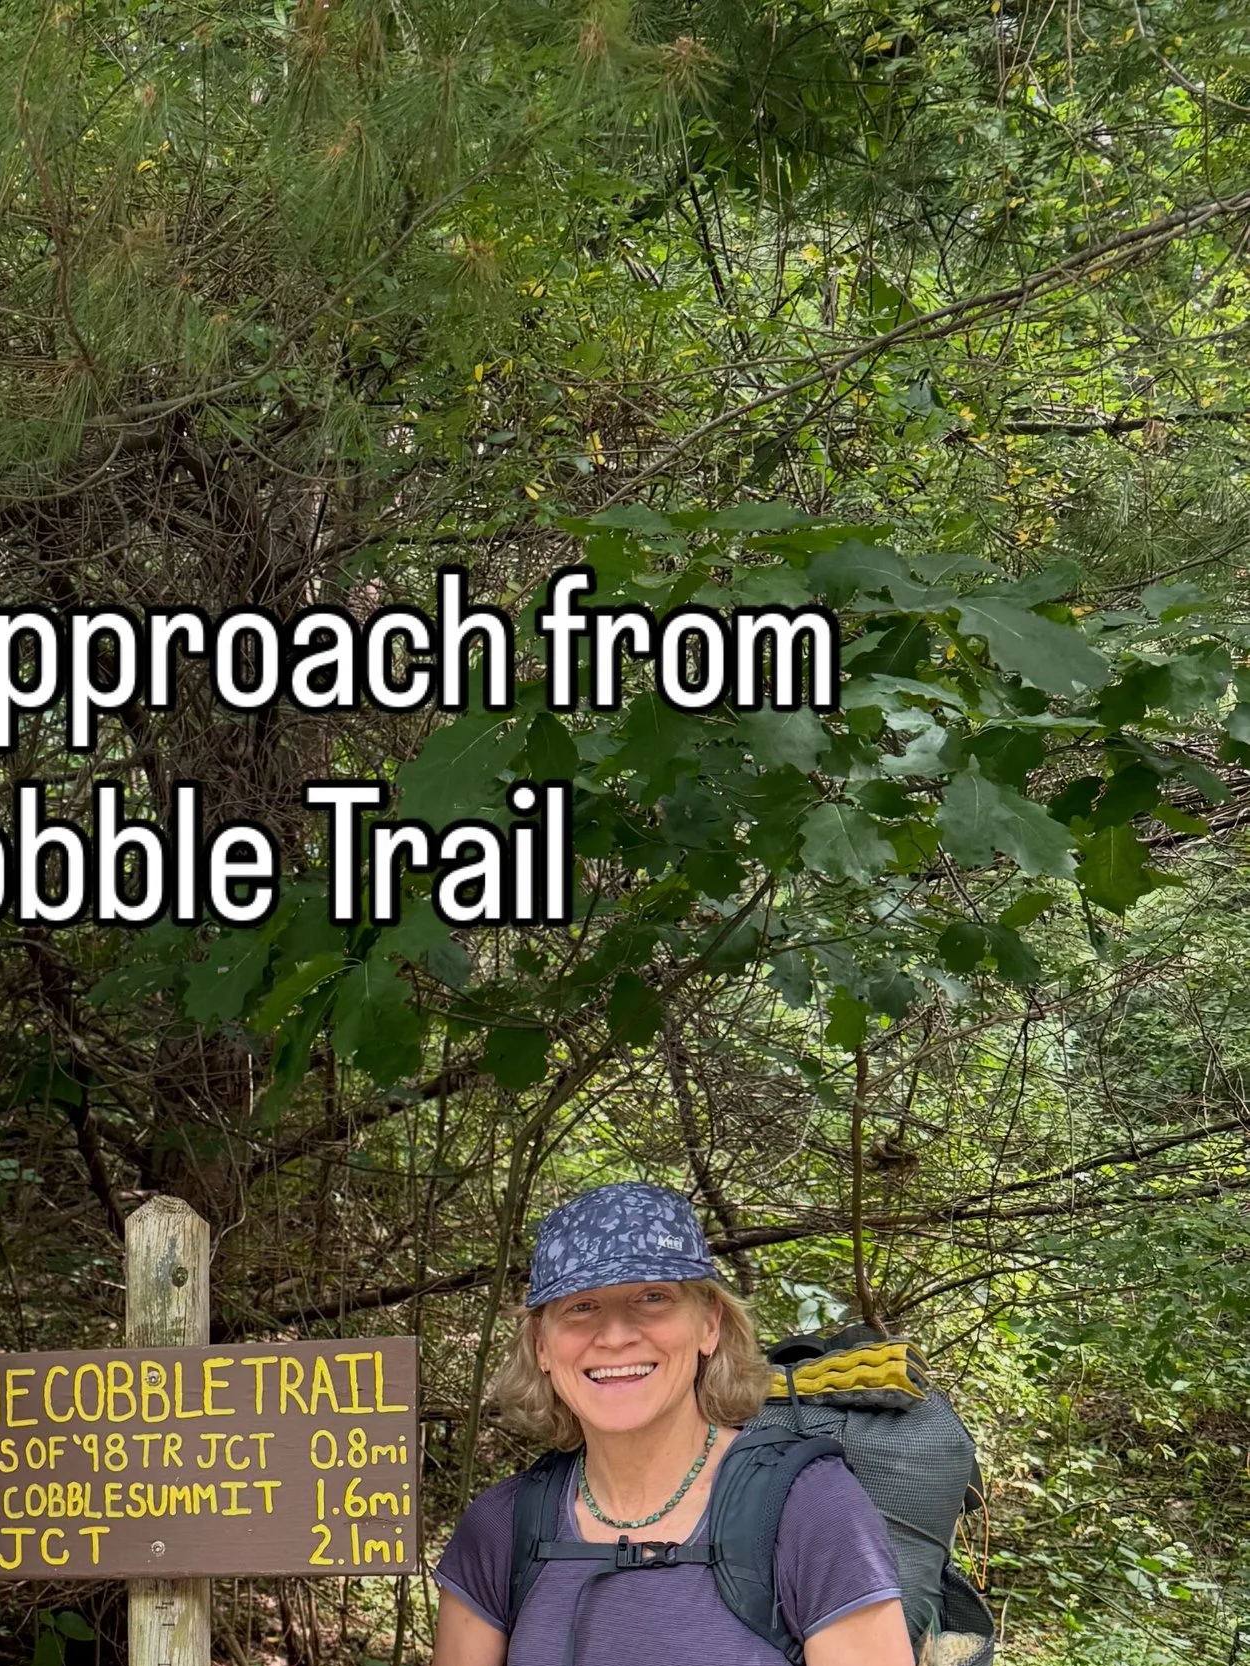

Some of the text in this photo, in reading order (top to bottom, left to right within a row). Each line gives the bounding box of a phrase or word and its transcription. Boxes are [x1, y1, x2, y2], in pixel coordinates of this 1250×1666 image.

[43, 1357, 236, 1423] COBBLE
[240, 1351, 410, 1416] TRAIL
[25, 1435, 68, 1470] OF
[132, 1432, 184, 1469] TR
[196, 1432, 276, 1470] JCT
[2, 1481, 125, 1520] COBBLE
[125, 1480, 283, 1519] SUMMIT
